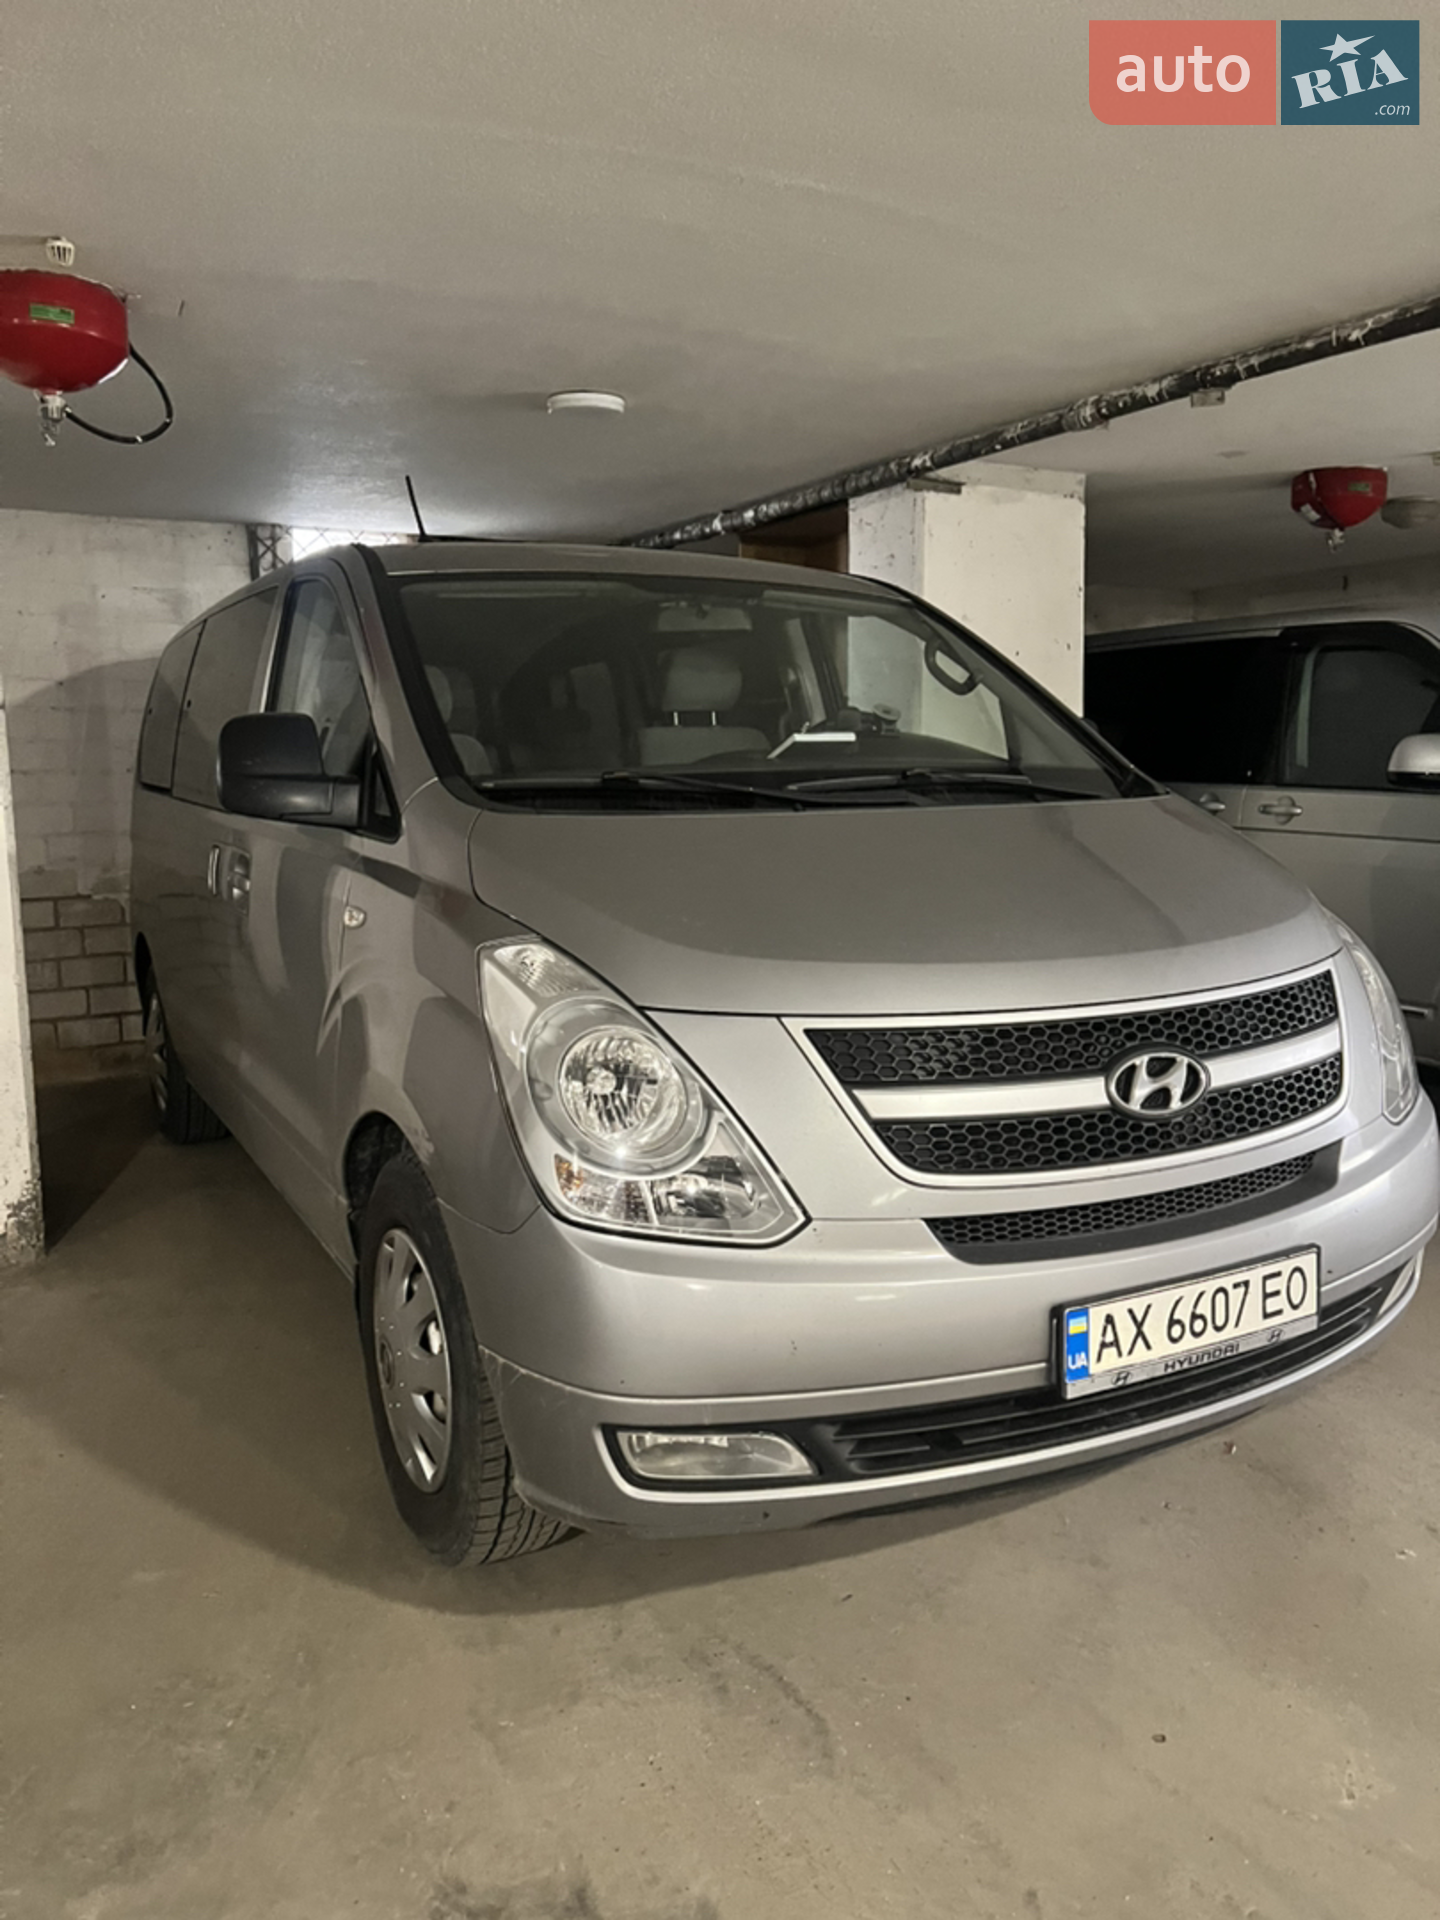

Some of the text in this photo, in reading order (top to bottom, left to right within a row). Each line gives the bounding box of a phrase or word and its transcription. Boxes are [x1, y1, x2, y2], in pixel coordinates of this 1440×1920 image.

[1096, 1266, 1308, 1364] AX 6607 EO
[1067, 1353, 1088, 1370] UA
[1163, 1343, 1240, 1373] HYUNDAI
